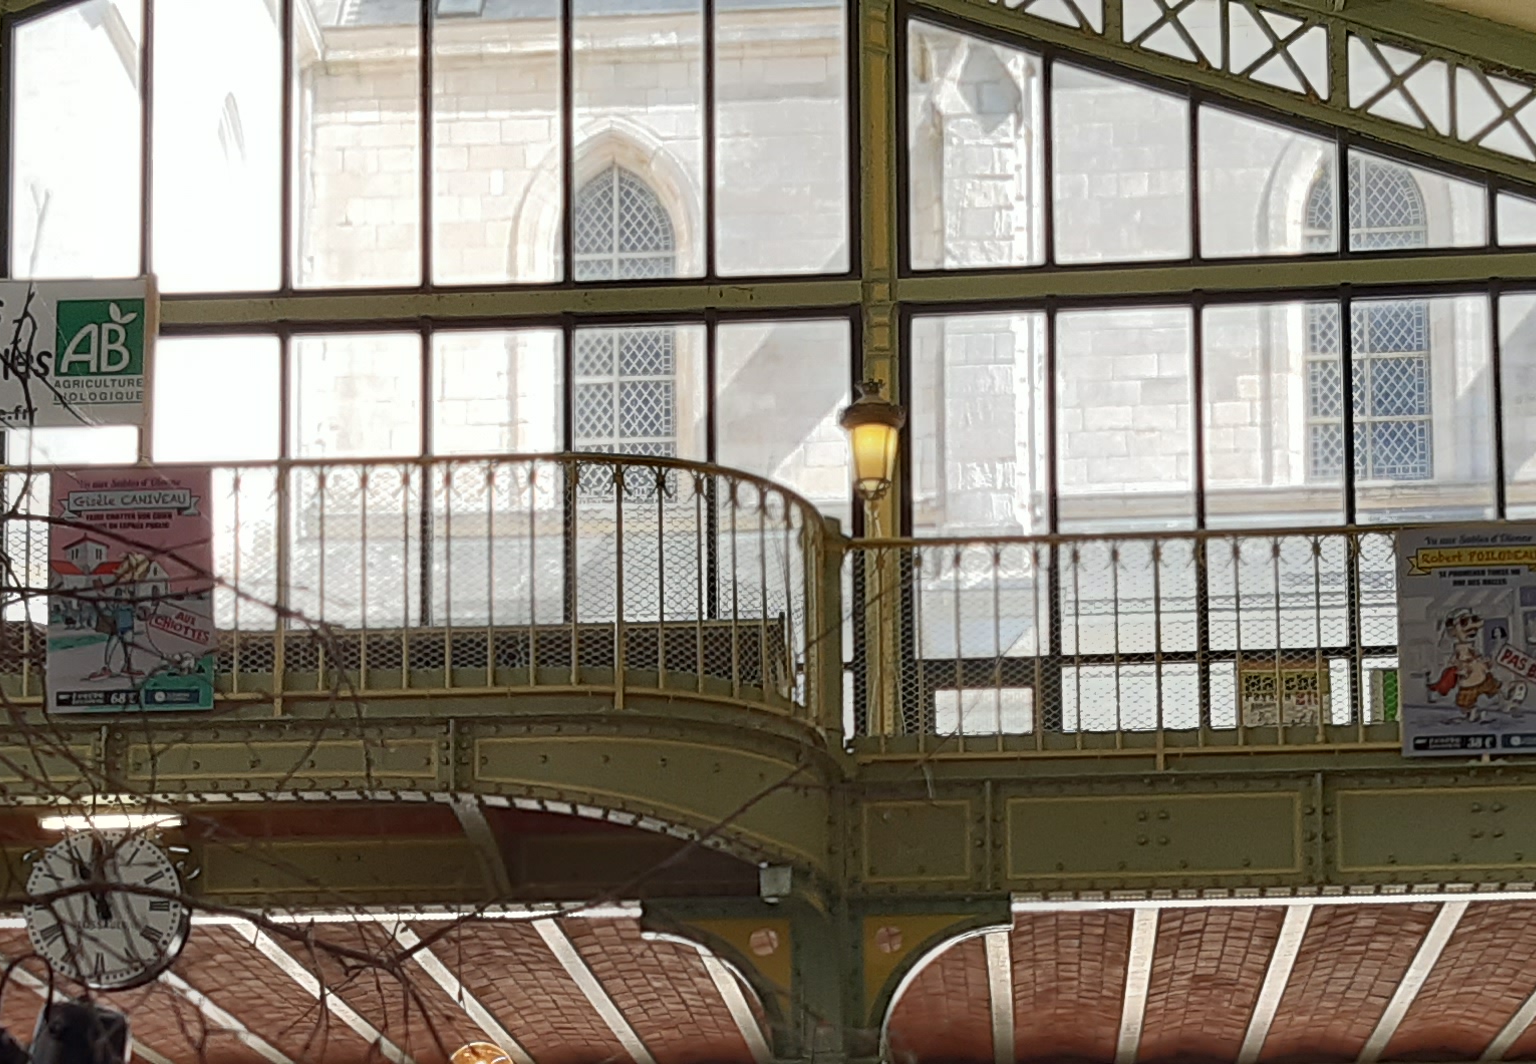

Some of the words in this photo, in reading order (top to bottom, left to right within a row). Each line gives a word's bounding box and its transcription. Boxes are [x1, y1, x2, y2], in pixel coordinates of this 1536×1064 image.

[60, 322, 130, 374] AB
[53, 377, 144, 389] AGRICULTURE
[73, 494, 115, 506] Gisèle
[120, 492, 186, 505] CANIVEAU
[1421, 551, 1463, 564] Robert
[154, 613, 210, 641] CHIOTTES
[1500, 648, 1527, 674] PAS
